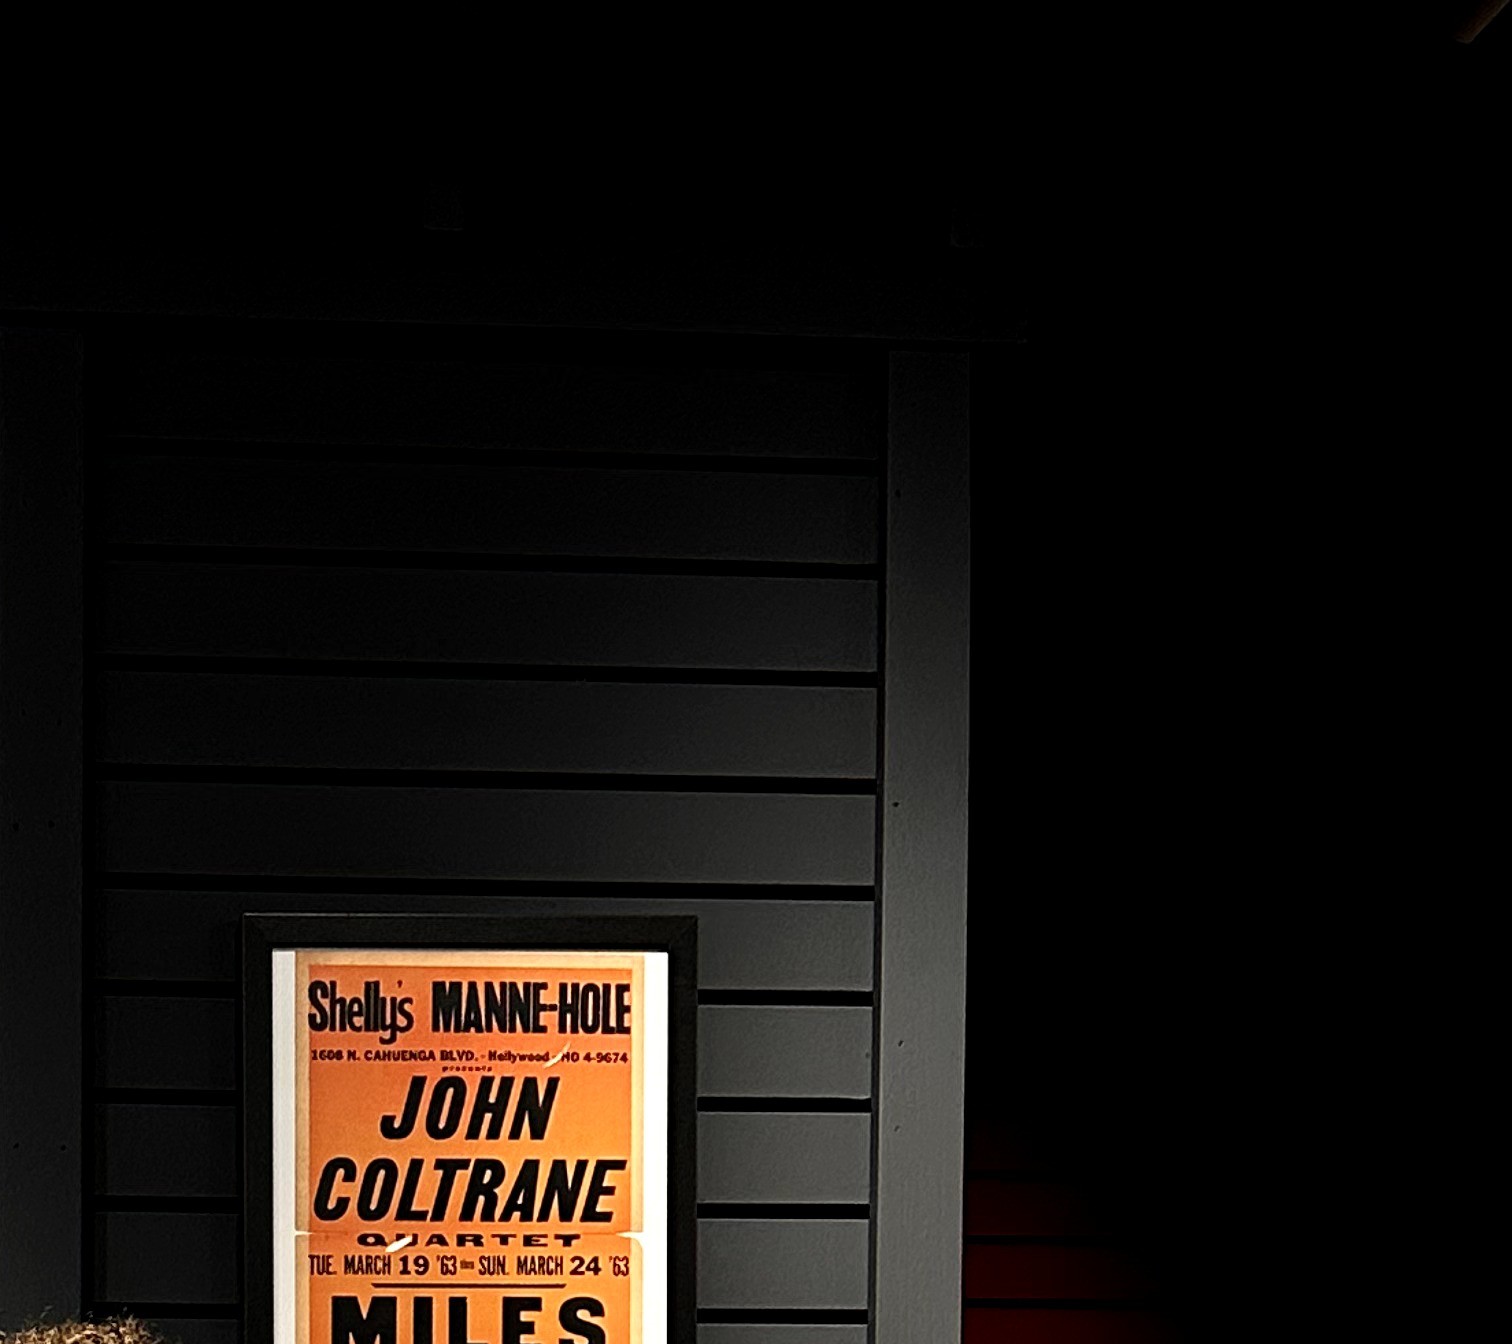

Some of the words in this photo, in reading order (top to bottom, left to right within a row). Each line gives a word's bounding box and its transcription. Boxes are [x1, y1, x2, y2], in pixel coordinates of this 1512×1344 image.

[308, 979, 414, 1044] Shelly's
[363, 1049, 436, 1061] CAHUENGA
[440, 1050, 479, 1062] BLVD.
[380, 1075, 560, 1141] JOHN
[313, 1157, 628, 1223] COLTRANE
[356, 1233, 582, 1248] QUARTET
[344, 1255, 391, 1276] MARCH
[399, 1255, 430, 1276] 19
[436, 1255, 457, 1276] '63
[478, 1255, 509, 1276] SUN.
[516, 1255, 564, 1276] MARCH
[569, 1255, 602, 1276] 24
[609, 1255, 630, 1277] '63
